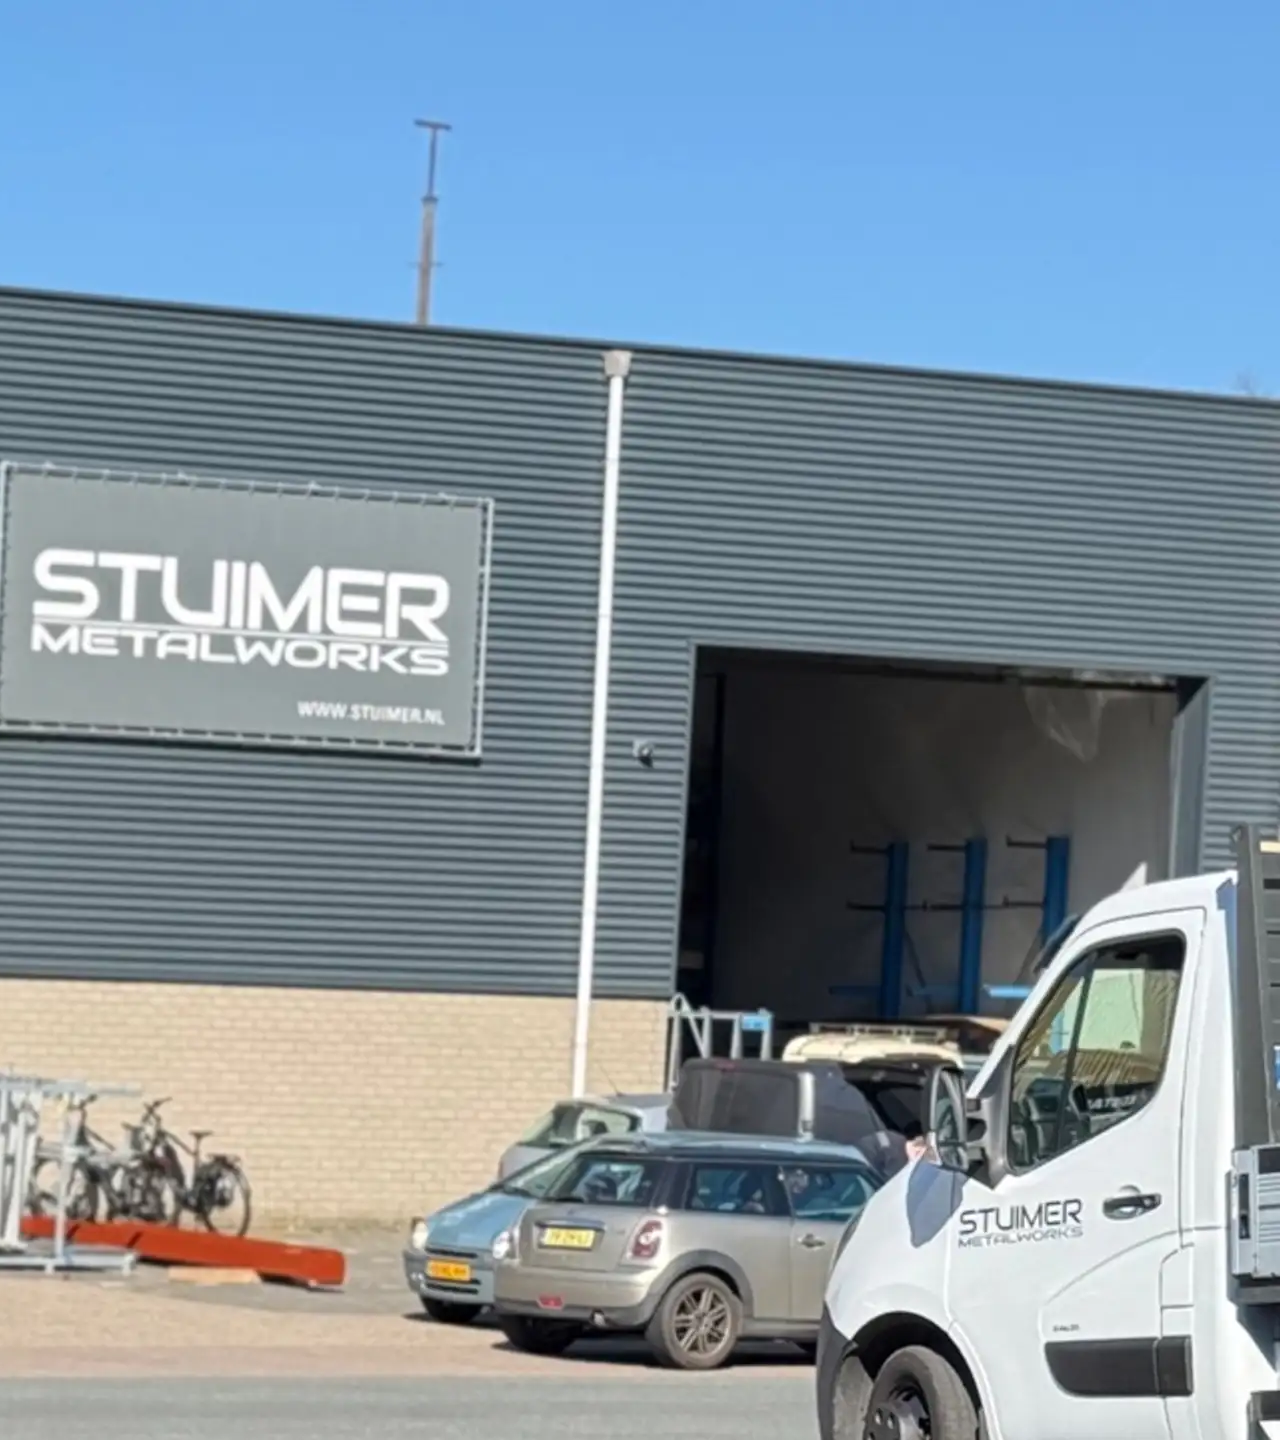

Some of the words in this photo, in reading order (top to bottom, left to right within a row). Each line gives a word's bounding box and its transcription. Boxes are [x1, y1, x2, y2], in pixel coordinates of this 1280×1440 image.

[32, 548, 450, 642] STUIMER
[30, 624, 449, 676] METALWORKS
[296, 700, 446, 726] WWW.STUIMER.NL
[958, 1198, 1083, 1236] STUIMER
[957, 1226, 1084, 1249] METALWORKS
